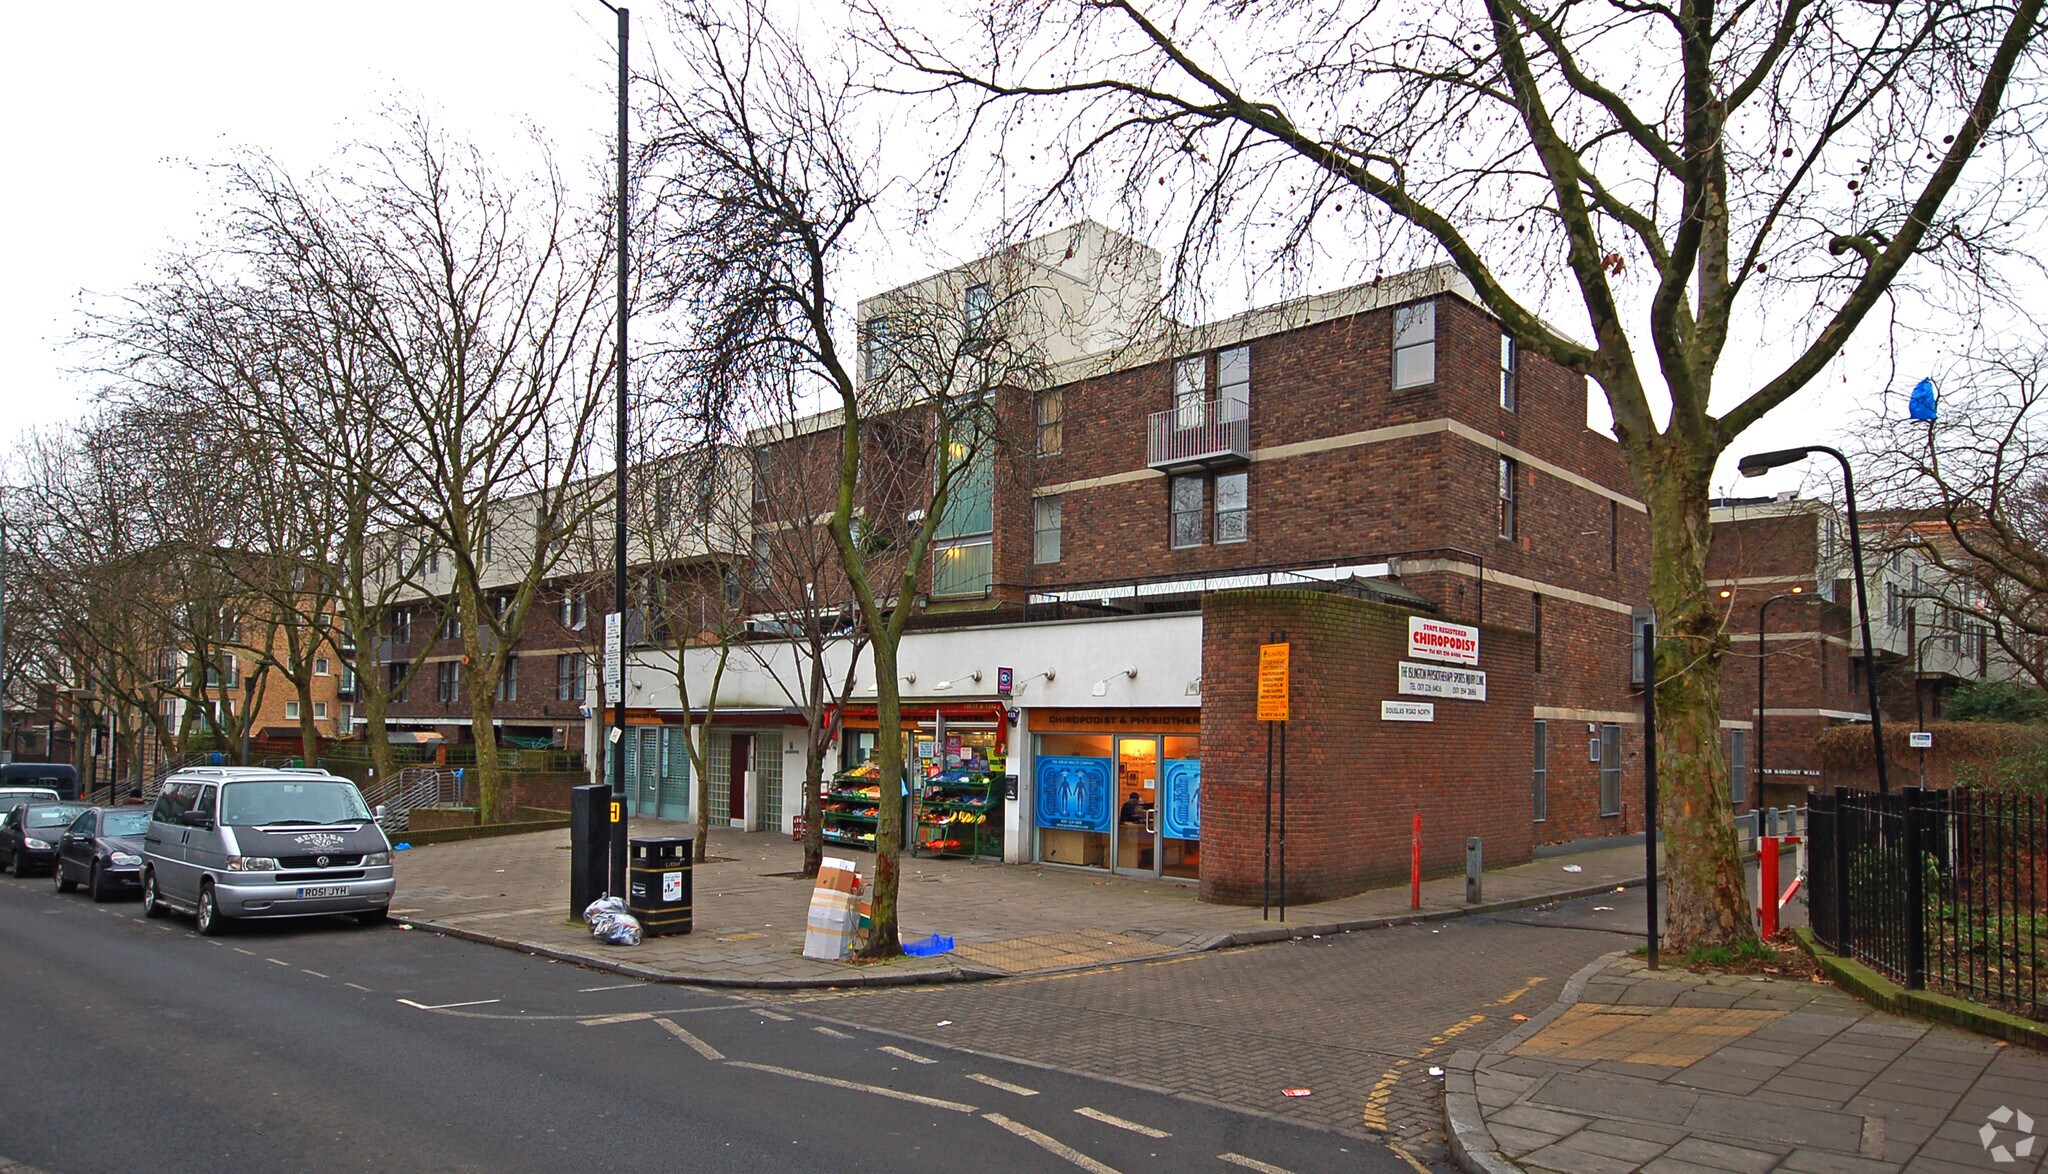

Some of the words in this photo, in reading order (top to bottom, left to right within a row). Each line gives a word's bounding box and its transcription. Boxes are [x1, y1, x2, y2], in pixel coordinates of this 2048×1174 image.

[1423, 624, 1438, 632] STATE
[1439, 626, 1467, 637] REGISTERED
[1413, 631, 1476, 652] CHIROPODIST
[1049, 716, 1116, 724] CHIROPODIST
[1120, 716, 1127, 724] &
[294, 834, 344, 844] MERTLER
[328, 886, 346, 896] JYH
